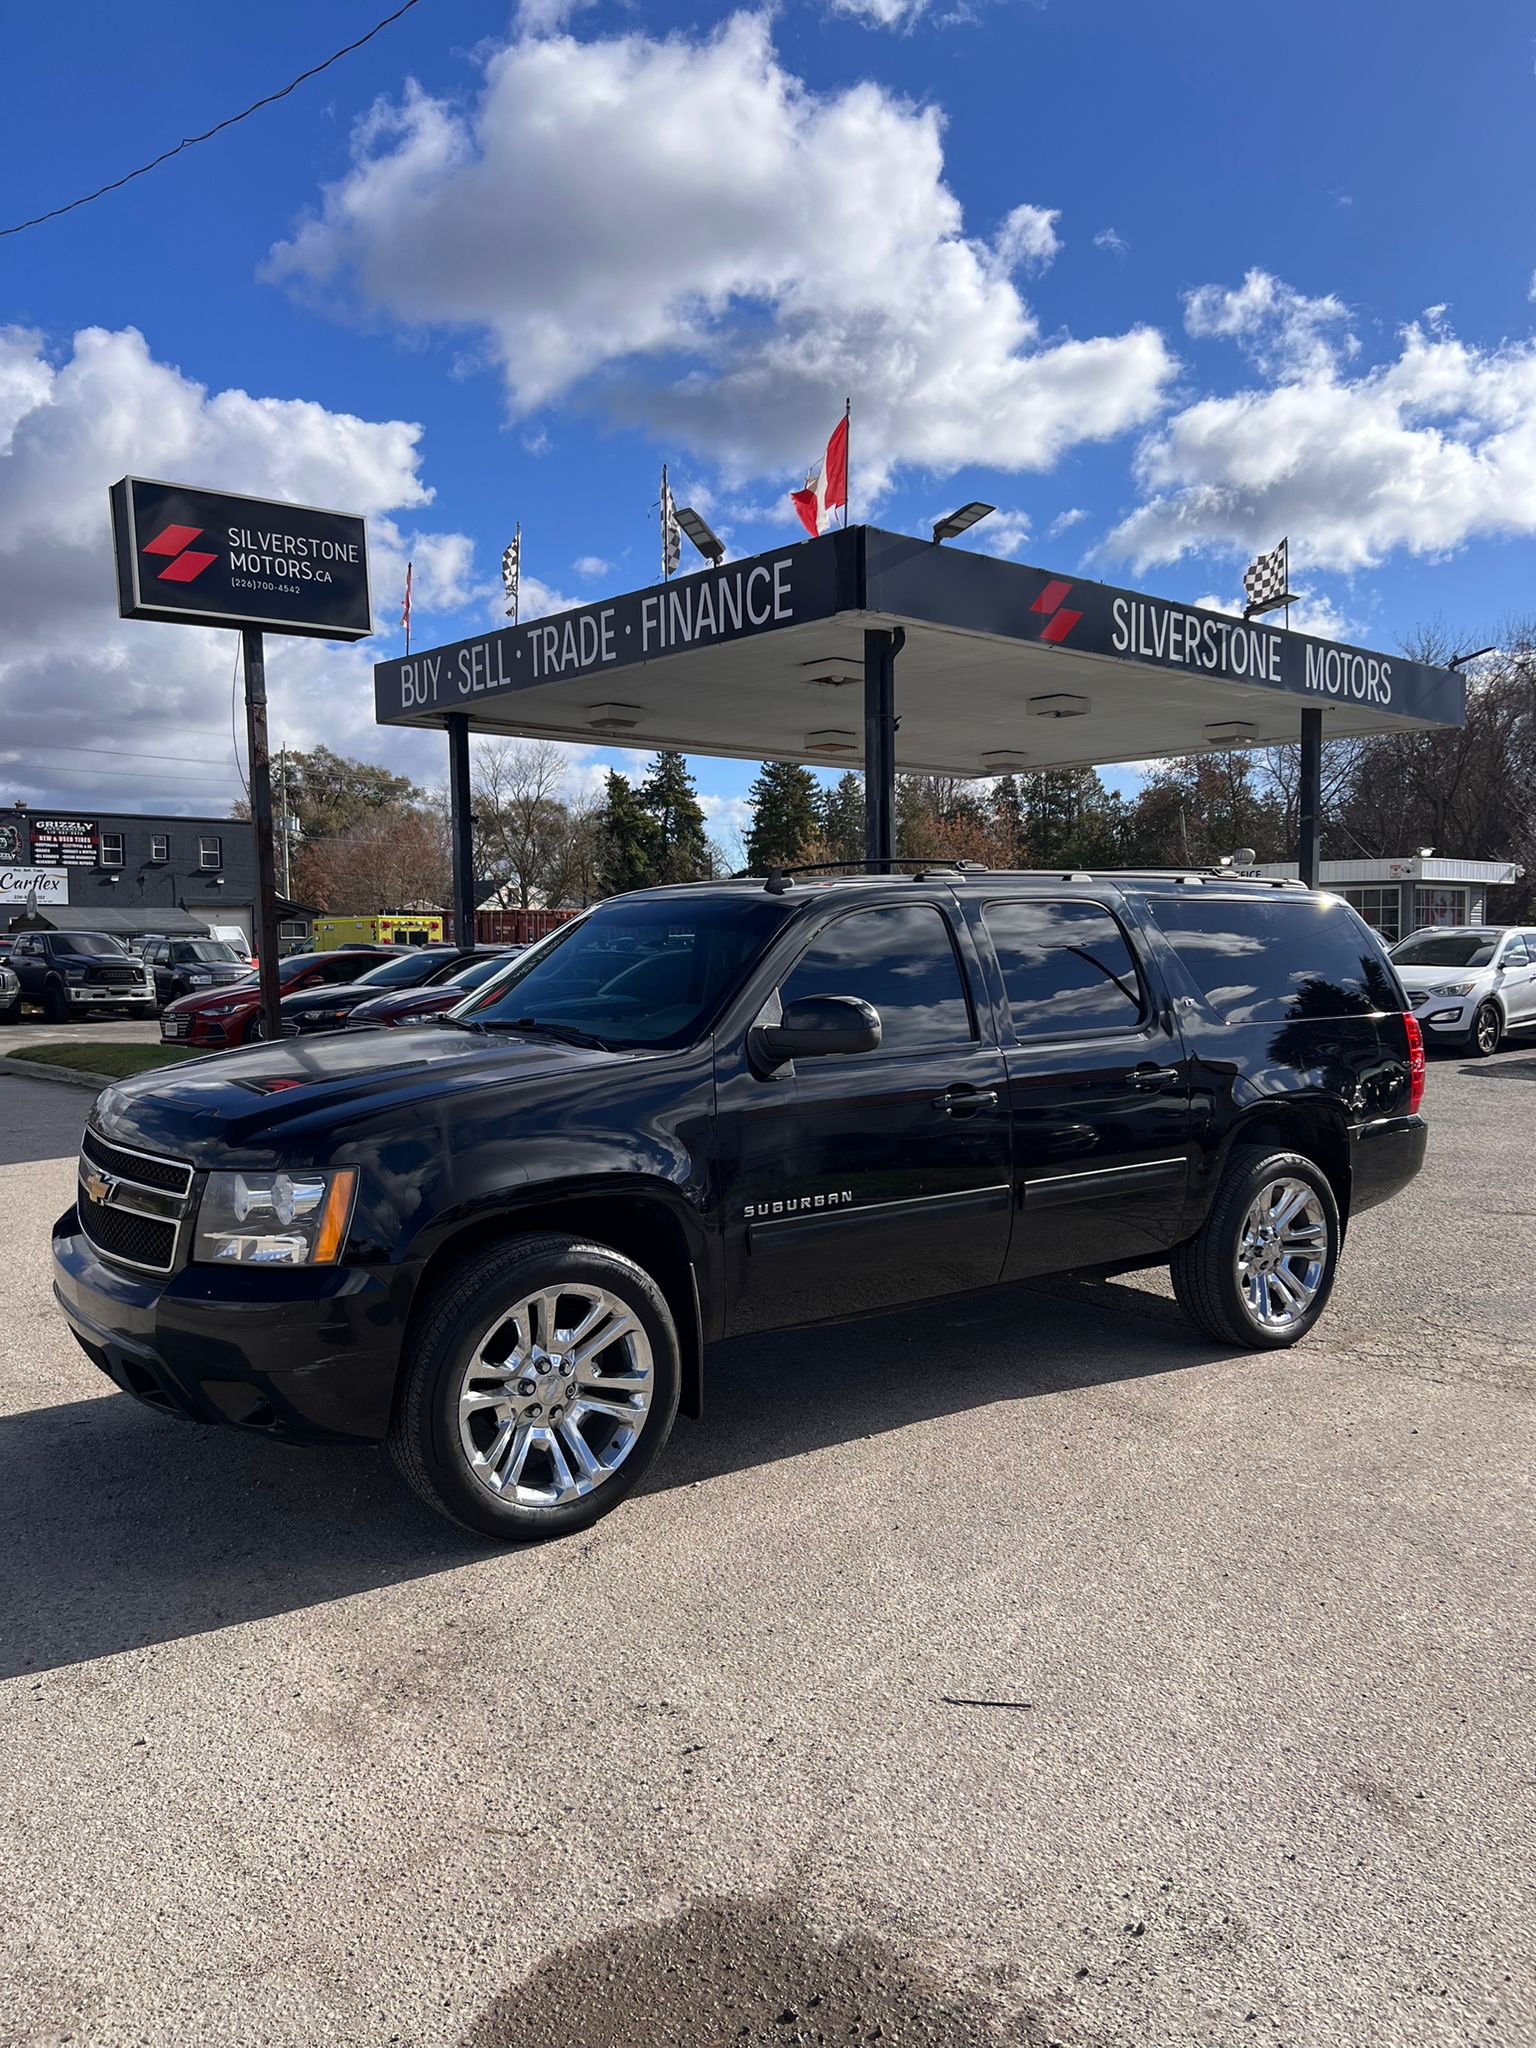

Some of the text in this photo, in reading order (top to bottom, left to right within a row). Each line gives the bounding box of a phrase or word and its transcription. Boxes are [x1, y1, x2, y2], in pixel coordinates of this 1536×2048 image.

[228, 527, 359, 563] SILVERSTONE
[230, 552, 332, 583] MOTORS.CA
[231, 577, 300, 594] (226)700-4542
[401, 558, 793, 708] BUY SELL TRADE FINANCE
[1111, 598, 1392, 705] SILVERSTONE MOTORS
[36, 821, 93, 830] GRIZZLY
[0, 872, 60, 891] Carflex
[743, 1190, 853, 1218] SUBURBAN
